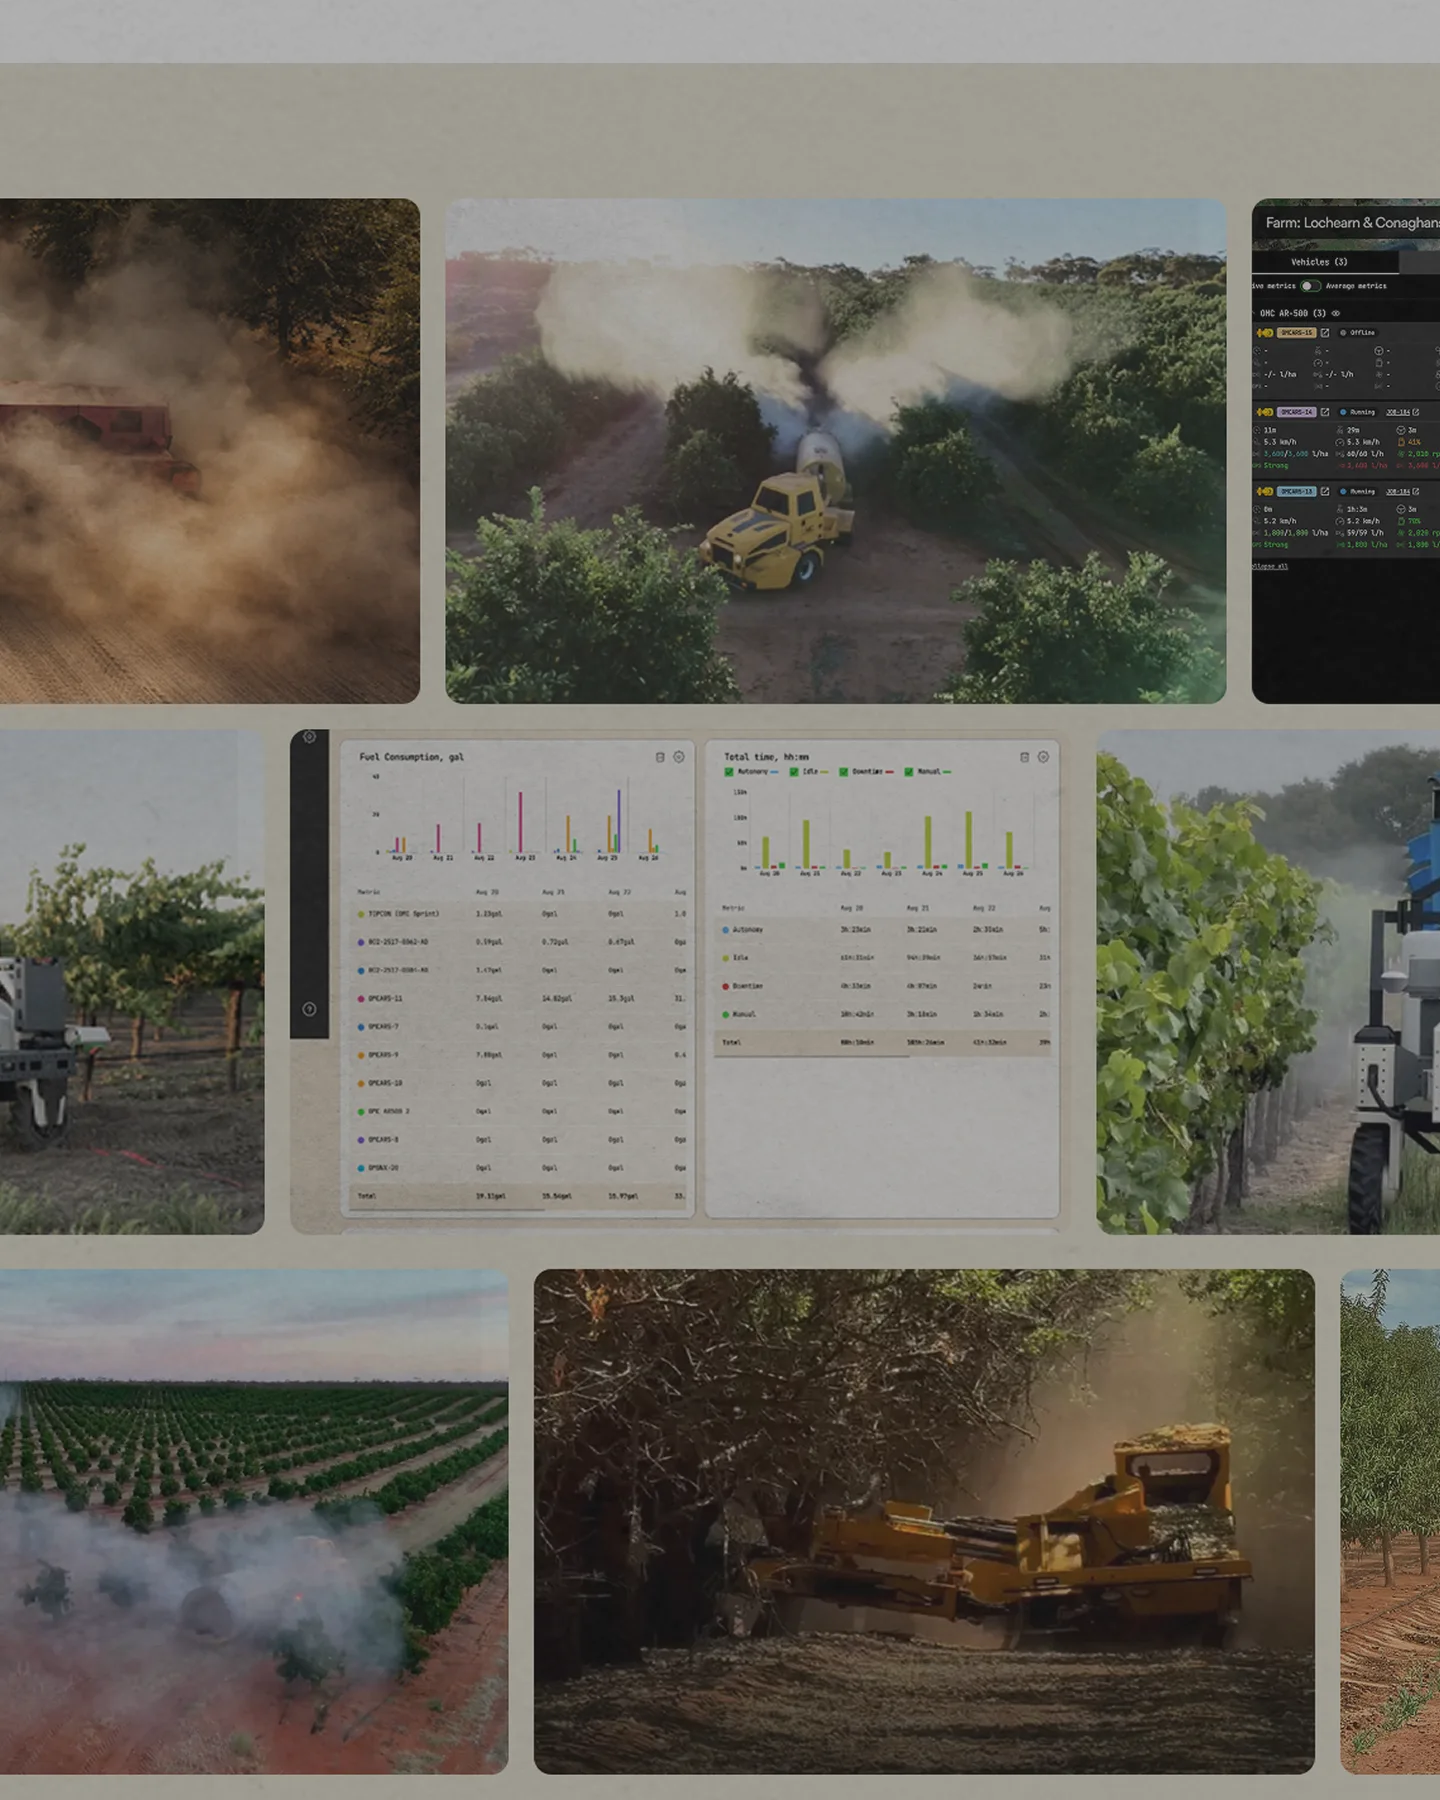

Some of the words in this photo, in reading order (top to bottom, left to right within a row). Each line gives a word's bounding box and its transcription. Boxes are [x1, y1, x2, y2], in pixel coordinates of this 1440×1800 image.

[1267, 217, 1300, 228] Farm:
[1305, 217, 1360, 228] Lochearn
[1363, 217, 1372, 228] &
[1292, 258, 1329, 266] Vehicles
[1335, 258, 1347, 266] (3)
[1260, 309, 1275, 317] OMC
[1313, 309, 1326, 317] (3)
[1264, 462, 1288, 470] Strong
[360, 753, 379, 761] Fuel
[384, 753, 443, 762] Consumption,
[449, 753, 464, 763] gal
[725, 753, 749, 761] Total
[755, 753, 778, 762] time,
